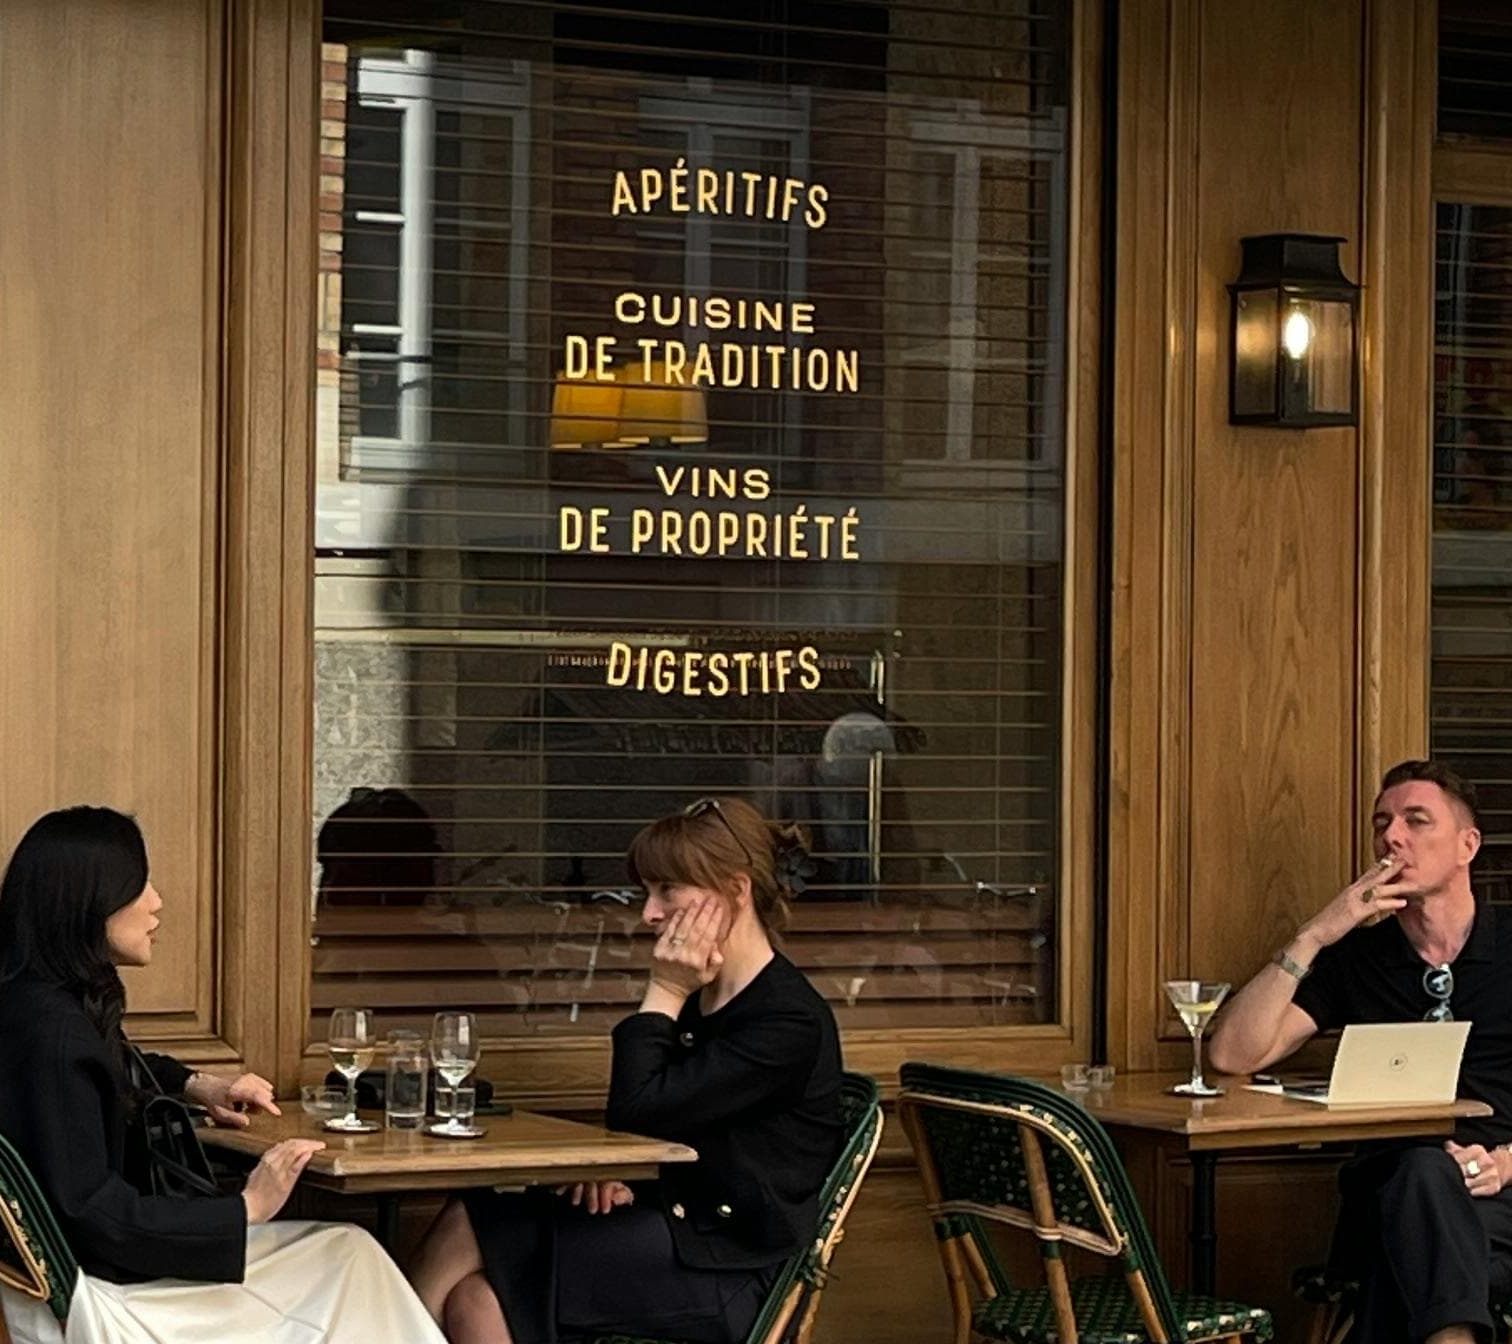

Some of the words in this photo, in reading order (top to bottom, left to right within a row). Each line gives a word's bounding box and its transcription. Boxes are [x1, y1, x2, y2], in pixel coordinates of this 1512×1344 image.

[612, 157, 829, 229] APÉRITIFS
[615, 293, 816, 334] CUISINE
[566, 335, 617, 382] DE
[638, 339, 859, 393] TRADITION
[655, 465, 771, 500] VINS
[560, 506, 610, 553] DE
[632, 504, 860, 559] PROPRIÉTÉ
[606, 639, 822, 697] DIGESTIFS
